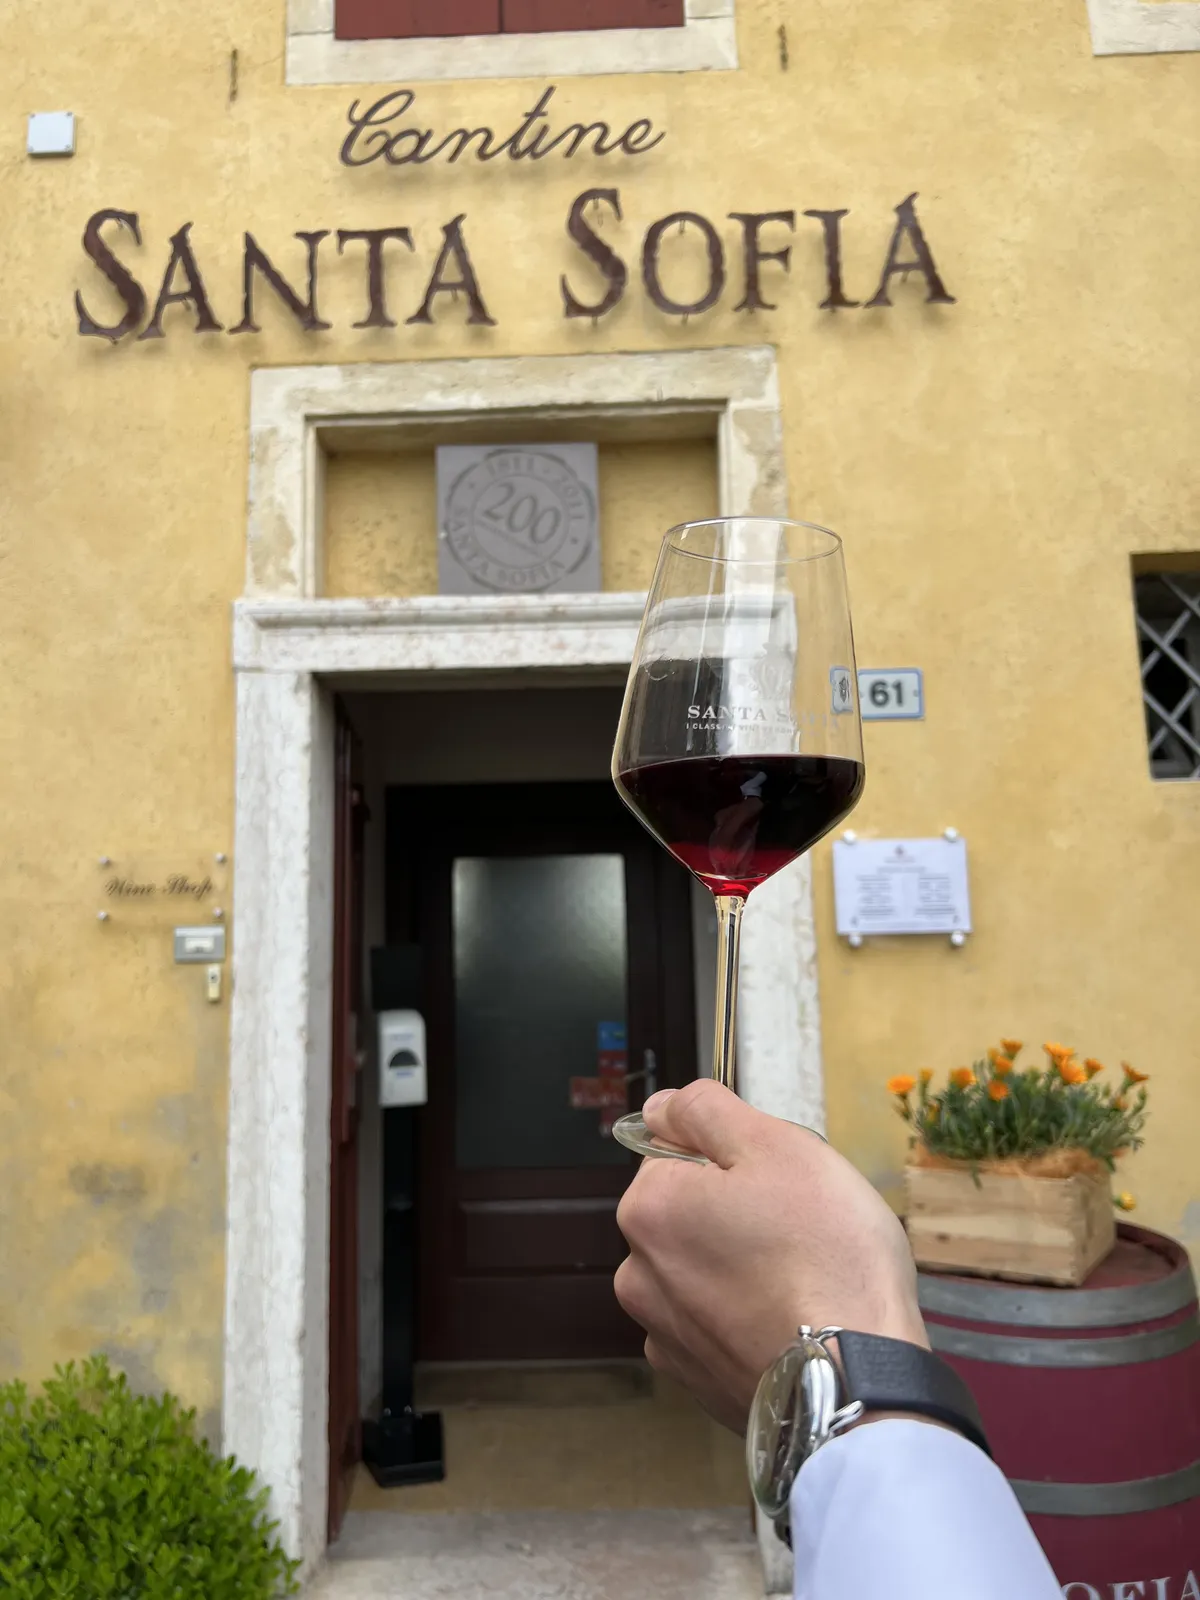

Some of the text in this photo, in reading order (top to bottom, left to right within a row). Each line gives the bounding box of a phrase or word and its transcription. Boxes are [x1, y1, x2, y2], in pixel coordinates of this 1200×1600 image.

[340, 86, 665, 167] Cantine
[75, 188, 955, 341] SANTA SOFIA
[482, 481, 562, 544] 200
[687, 705, 767, 721] SANTA
[868, 681, 905, 708] 61
[1060, 1570, 1200, 1600] OFIA
